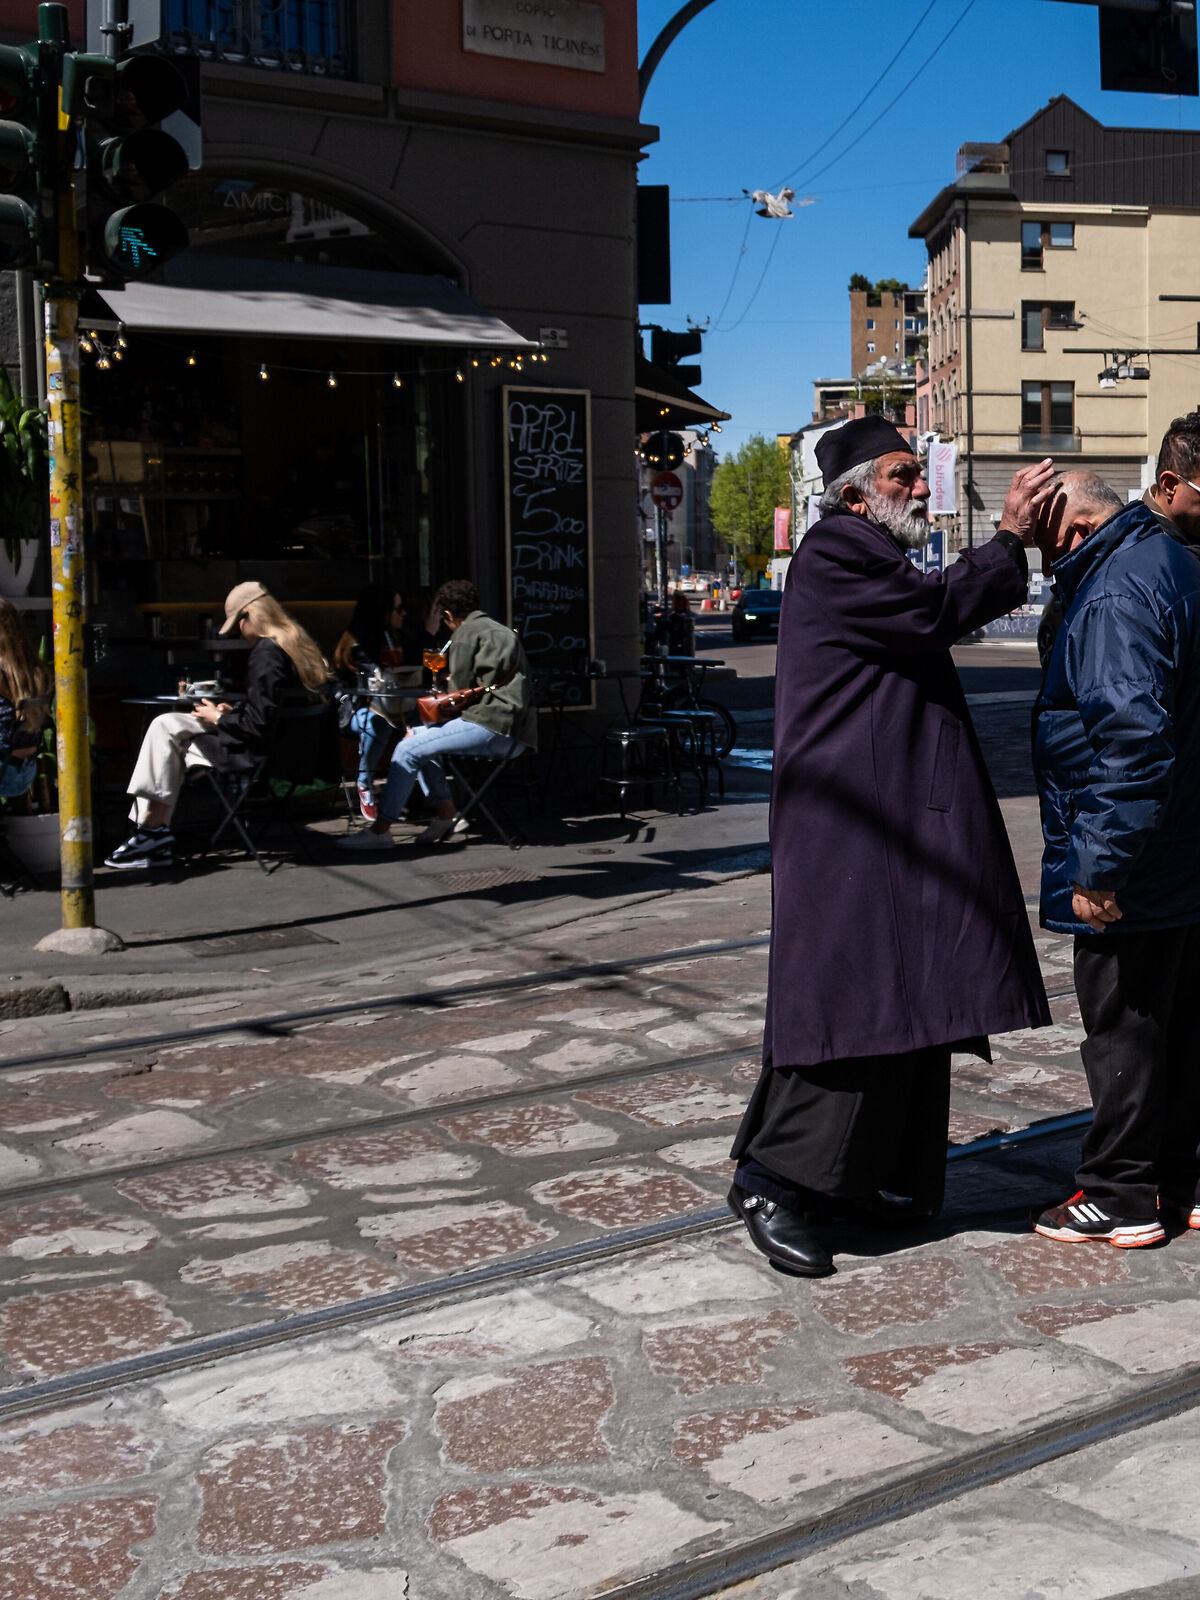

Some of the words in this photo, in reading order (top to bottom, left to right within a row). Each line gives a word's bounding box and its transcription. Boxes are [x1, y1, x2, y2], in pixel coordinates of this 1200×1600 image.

[515, 2, 556, 18] CORSO
[466, 25, 476, 37] DI
[482, 24, 533, 46] PORTA
[542, 34, 602, 56] TICINESE
[508, 401, 584, 455] APEROL
[512, 453, 585, 483] SPRITZ
